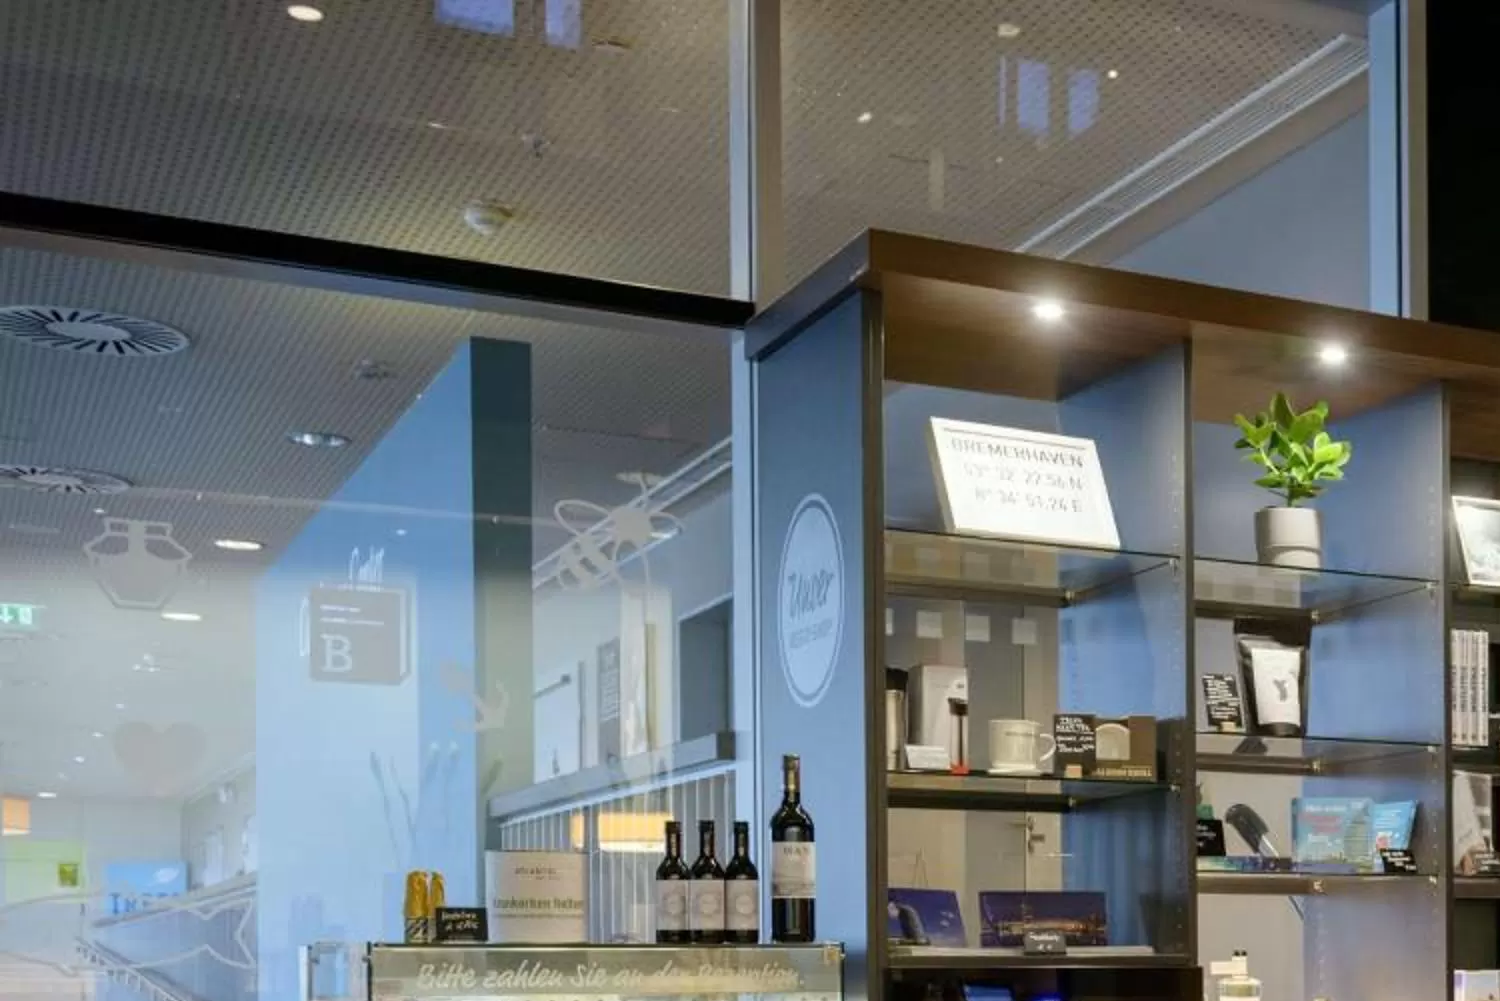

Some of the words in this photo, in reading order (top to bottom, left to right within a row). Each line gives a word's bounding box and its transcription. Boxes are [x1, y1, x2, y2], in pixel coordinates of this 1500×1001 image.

[416, 961, 477, 991] Bitte
[481, 959, 562, 989] zahlen
[569, 962, 610, 989] Sie
[613, 969, 643, 989] an
